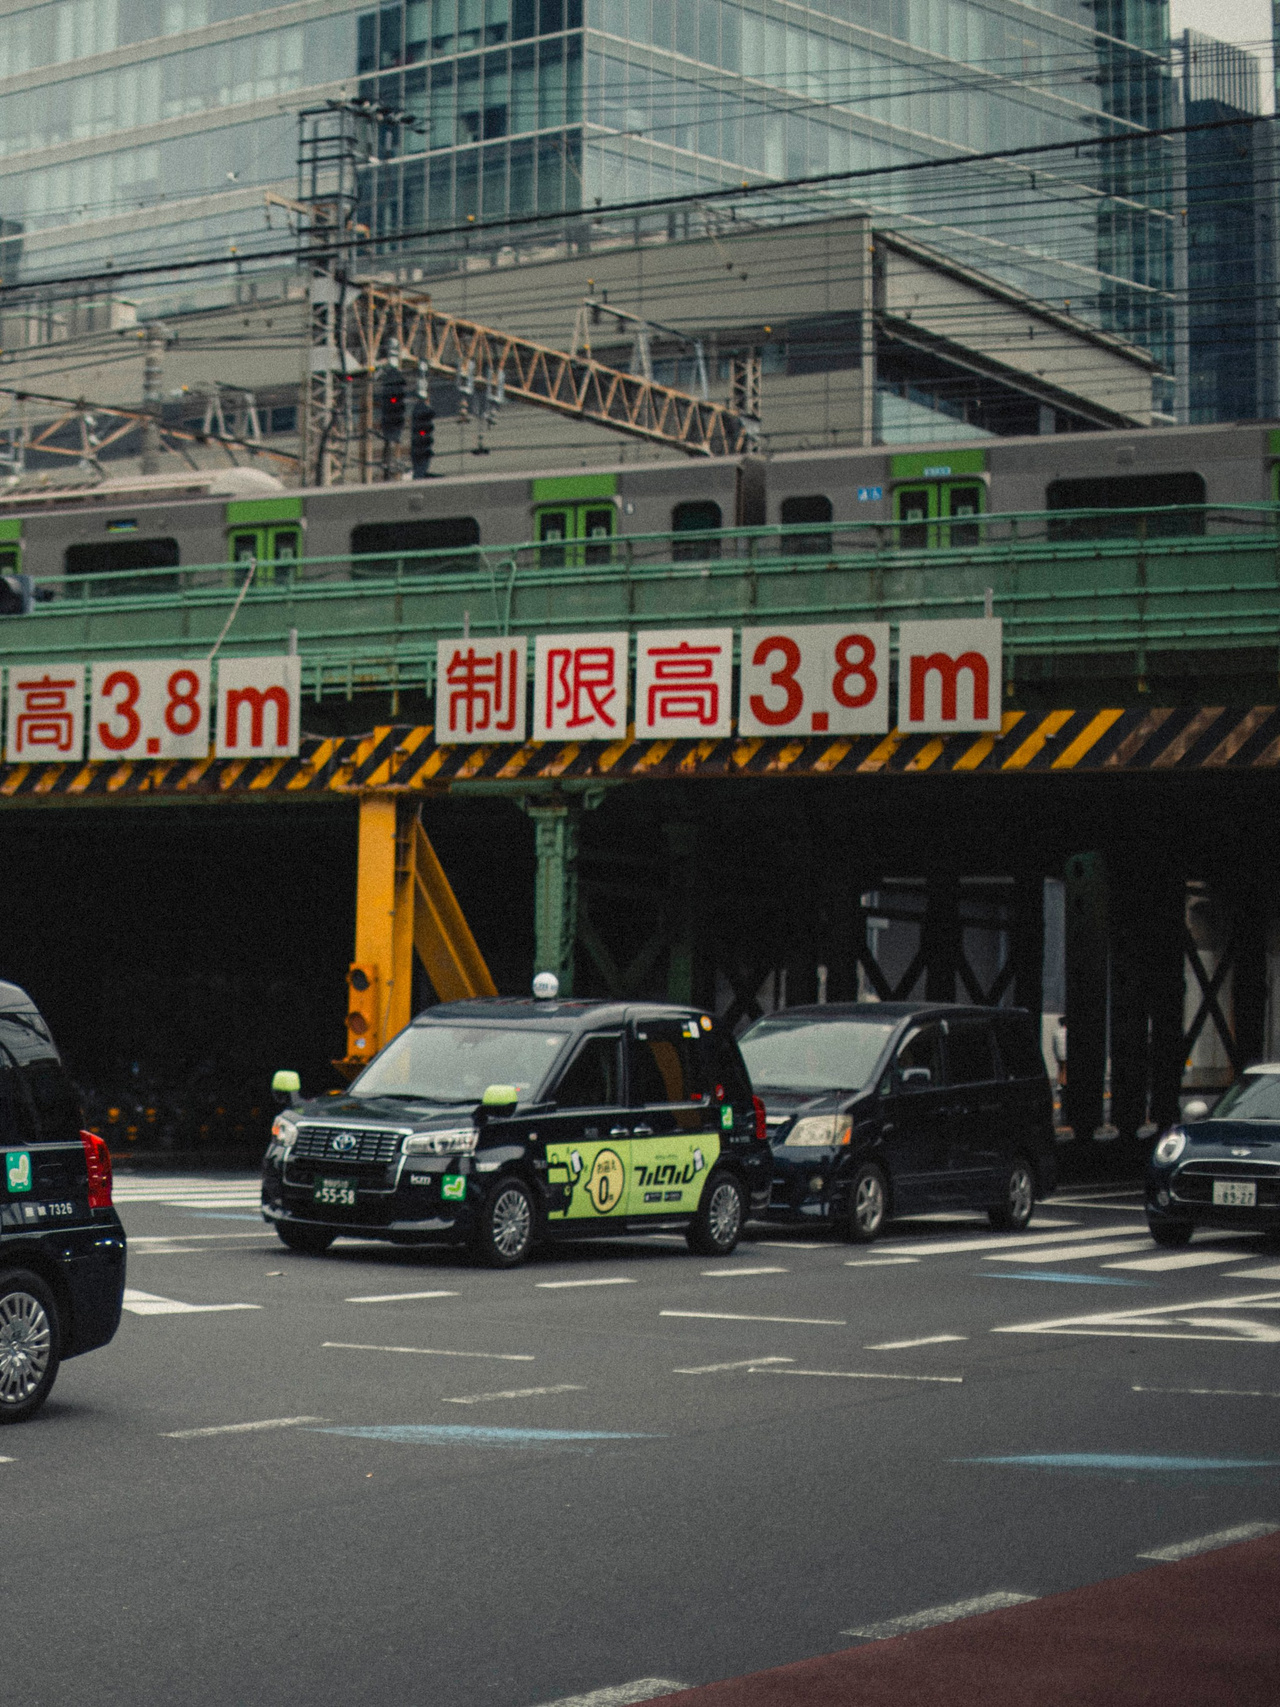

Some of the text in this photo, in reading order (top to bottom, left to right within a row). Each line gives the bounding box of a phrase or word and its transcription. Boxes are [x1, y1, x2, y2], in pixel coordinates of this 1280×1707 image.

[445, 633, 990, 732] 制限高3.8m
[48, 1202, 73, 1216] 7326
